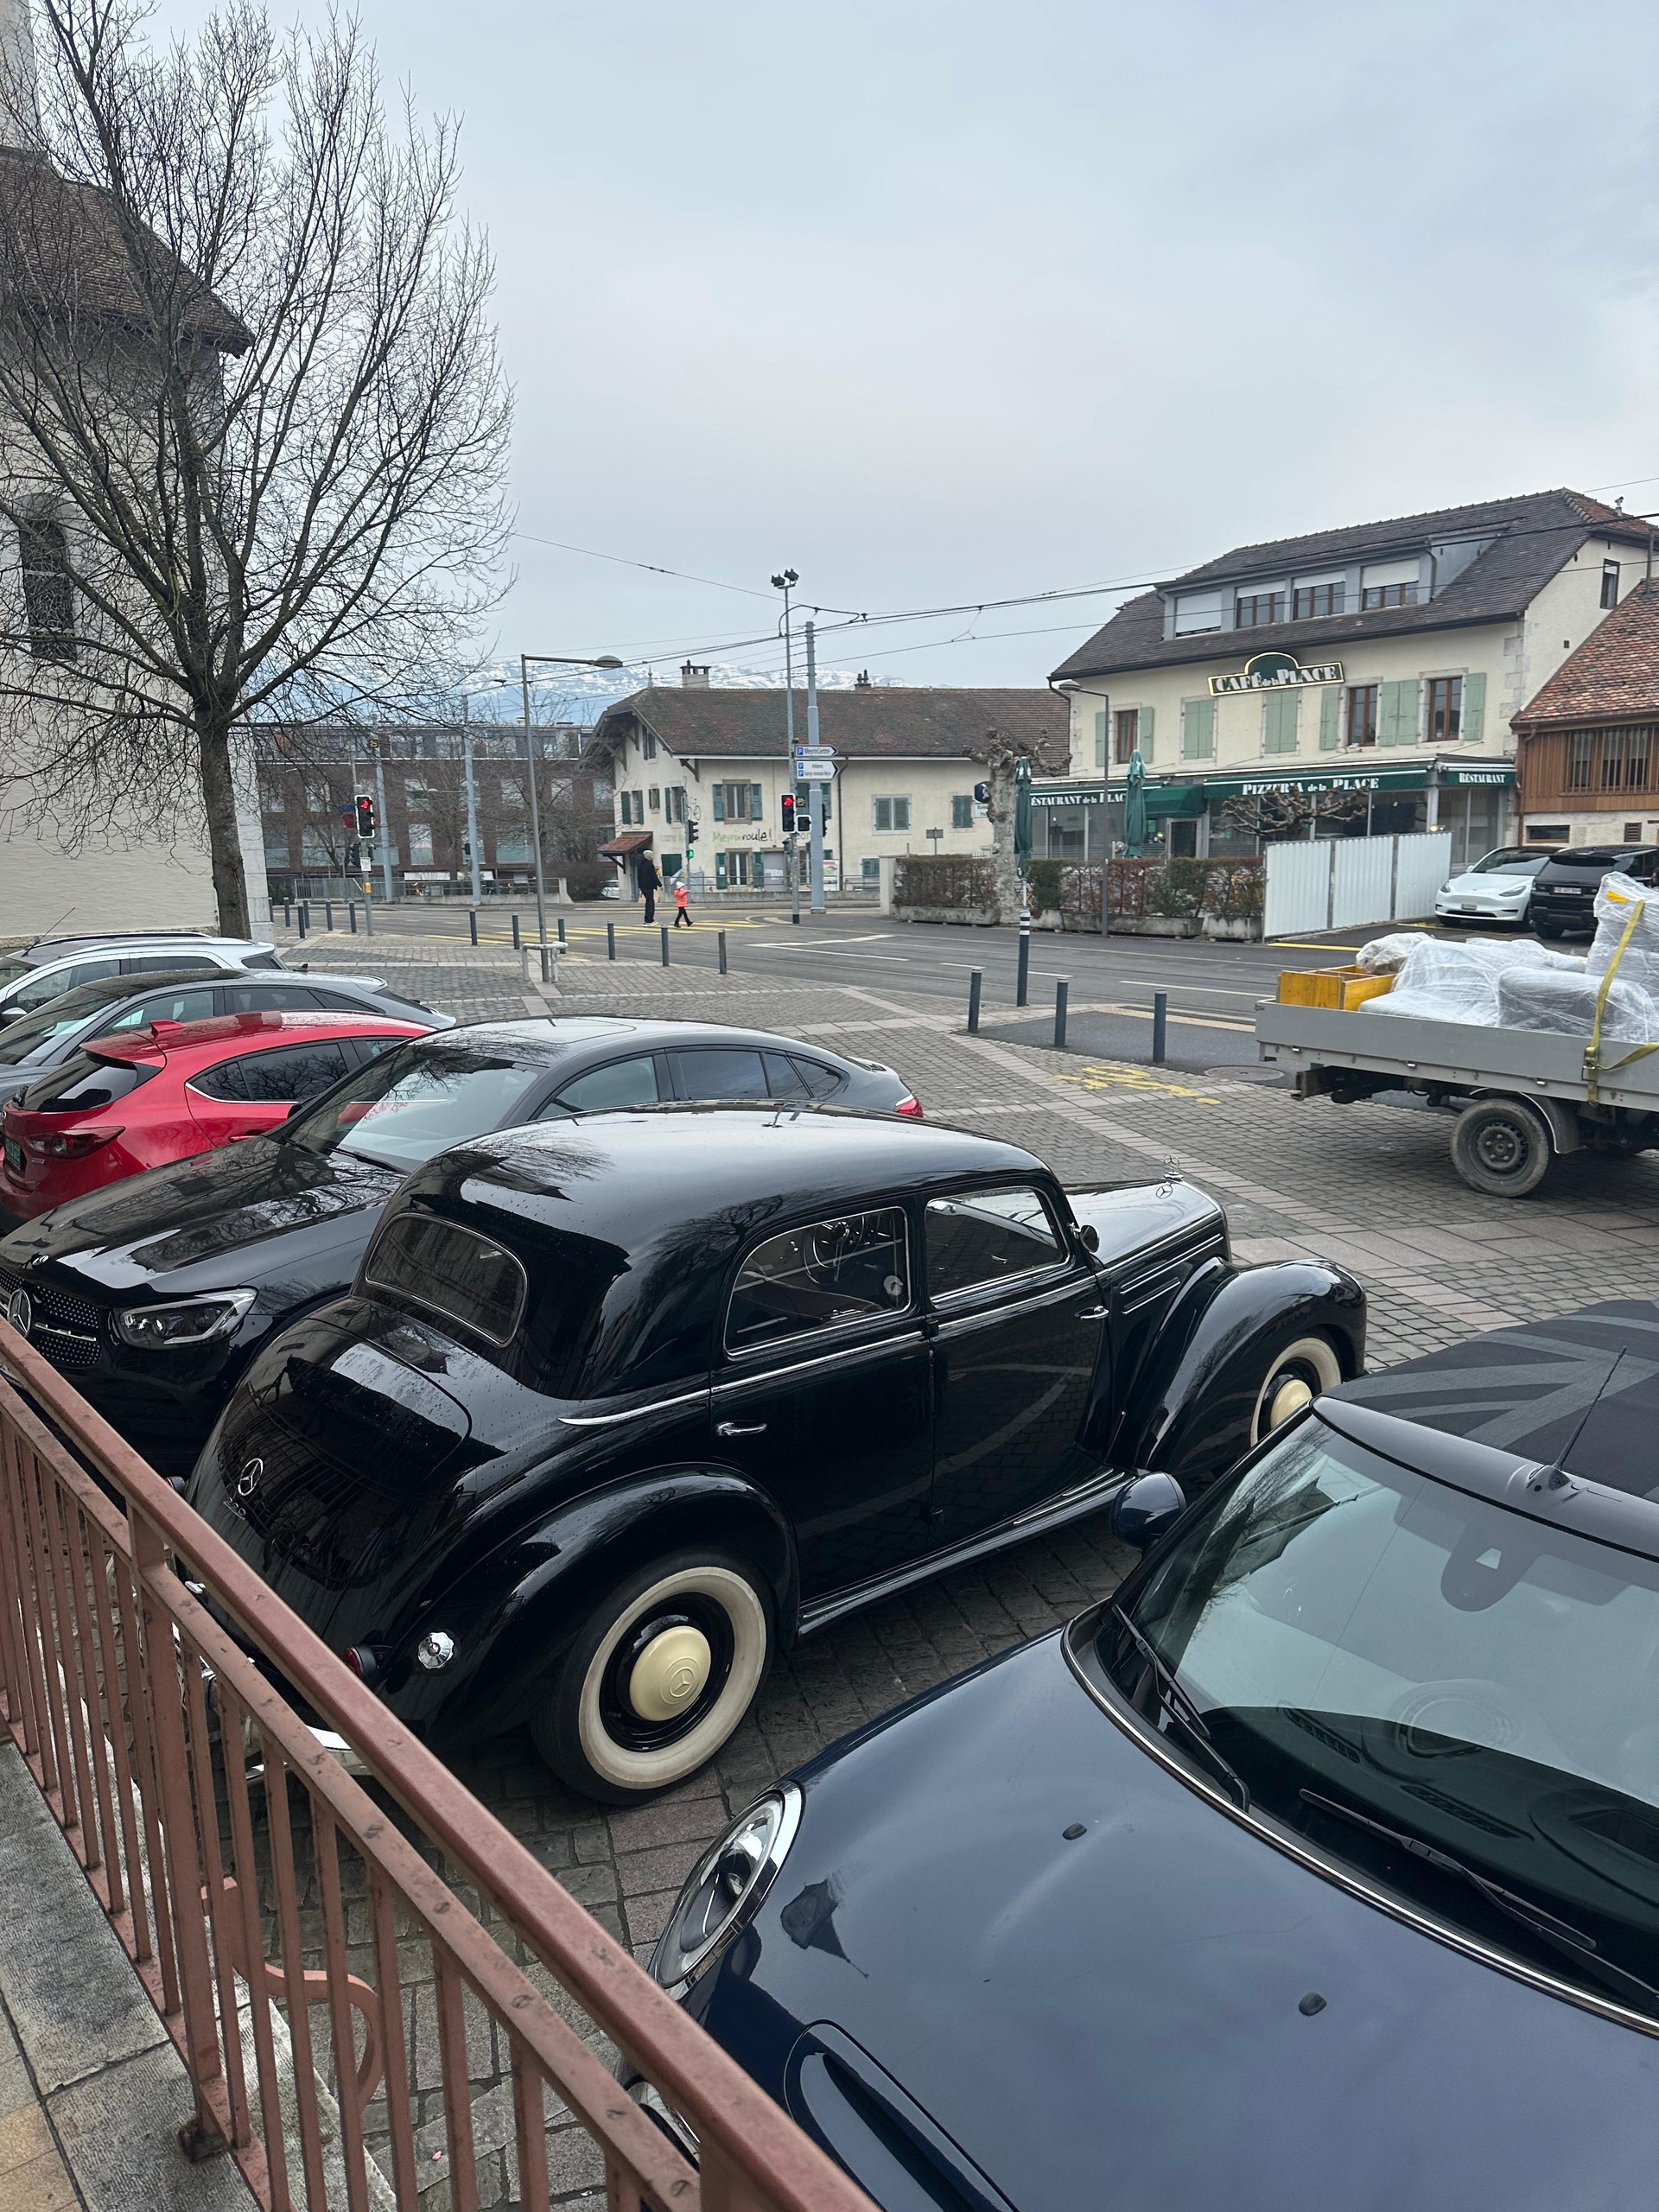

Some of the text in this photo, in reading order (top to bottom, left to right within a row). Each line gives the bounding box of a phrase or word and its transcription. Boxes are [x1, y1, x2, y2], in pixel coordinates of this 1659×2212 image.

[1216, 671, 1262, 691] CAFÉ
[1276, 666, 1337, 685] PLACE
[1243, 778, 1380, 795] PIZZERA de la PLACE
